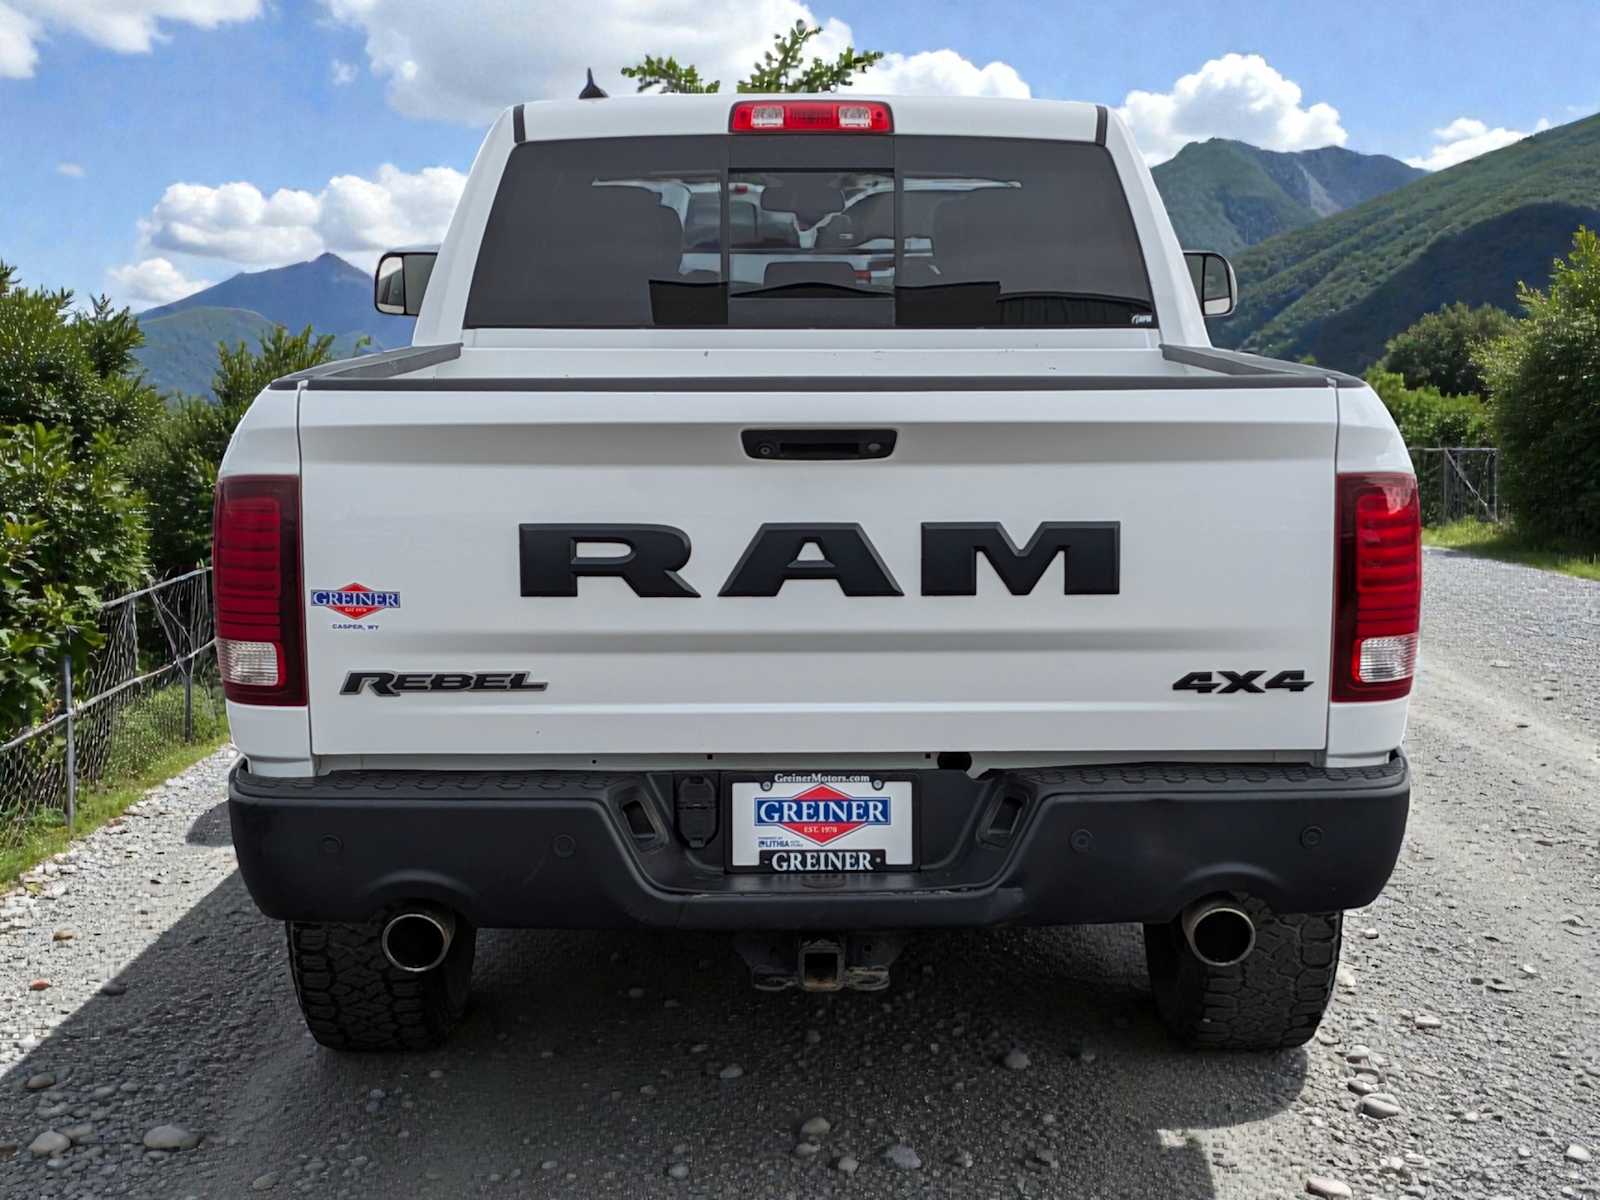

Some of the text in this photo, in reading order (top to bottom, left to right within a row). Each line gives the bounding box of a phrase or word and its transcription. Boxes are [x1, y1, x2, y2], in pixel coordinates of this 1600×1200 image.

[519, 521, 1121, 598] RAM
[313, 591, 398, 607] GREINER
[339, 670, 549, 697] REBEL
[774, 773, 870, 783] GreinerMotors.com
[759, 801, 885, 822] GREINER
[771, 851, 874, 871] GREINER
